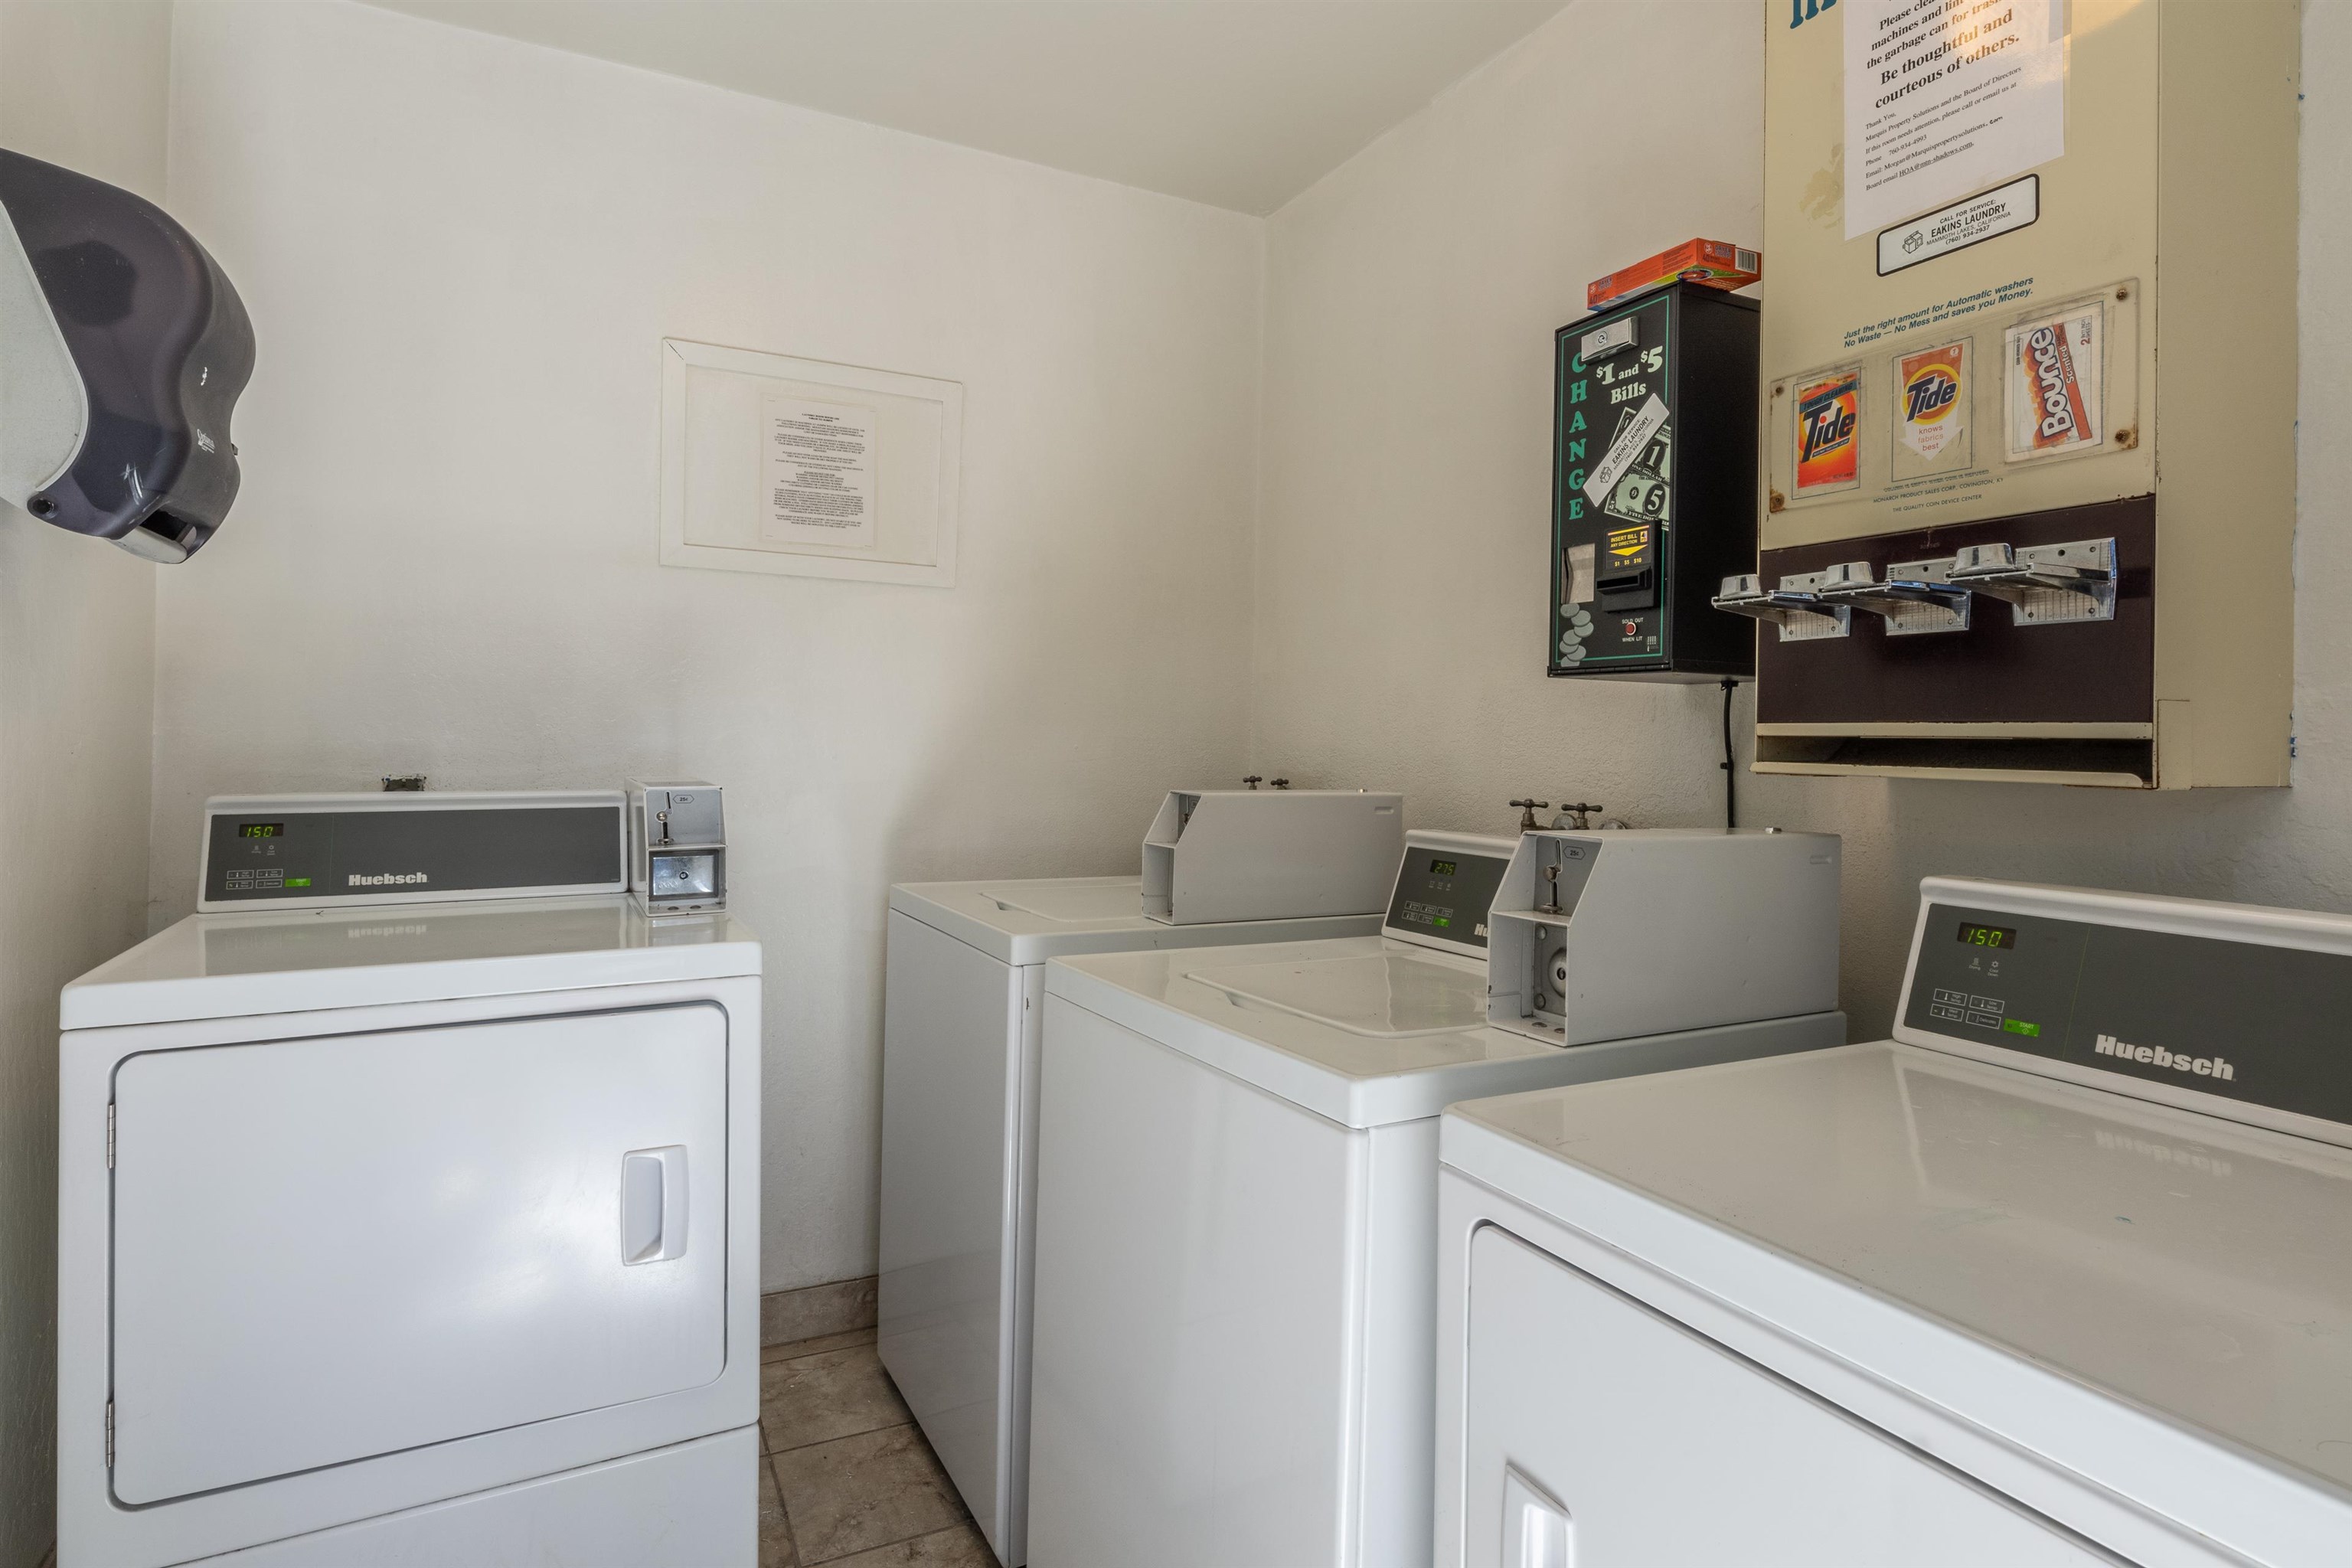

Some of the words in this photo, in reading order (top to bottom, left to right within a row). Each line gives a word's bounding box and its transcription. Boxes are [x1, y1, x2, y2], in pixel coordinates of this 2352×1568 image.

[1871, 20, 1919, 51] machines
[1921, 6, 1942, 24] and
[1879, 9, 1911, 31] Please
[1867, 54, 1881, 69] the
[1884, 33, 1926, 61] garbage
[1929, 21, 1949, 37] can
[1952, 11, 1968, 26] for
[1880, 64, 1899, 85] Be
[1902, 26, 1979, 74] thoughtful
[1983, 8, 2014, 34] and
[1875, 68, 1943, 109] courteous
[1947, 57, 1962, 74] of
[1965, 34, 2020, 65] others.
[1866, 129, 1887, 142] Marquis
[1888, 117, 1912, 131] Property
[1913, 101, 1939, 120] Solutions
[1940, 98, 1952, 107] and
[1963, 83, 1982, 96] Board
[1983, 79, 1991, 87] of
[1992, 67, 2021, 83] Directors
[1865, 119, 1882, 129] Thank
[1882, 137, 1896, 147] room
[1897, 129, 1913, 139] needs
[1914, 117, 1941, 132] attention,
[1942, 107, 1961, 121] please
[1962, 101, 1973, 110] call
[1982, 89, 2000, 101] email
[1865, 155, 1882, 166] Phone
[1865, 179, 1883, 191] Board
[1883, 172, 1898, 183] email
[1931, 220, 1962, 238] EAKINS
[1965, 203, 2006, 226] LAUNDRY
[1939, 215, 1954, 224] CALL
[1955, 210, 1968, 218] FOR
[1969, 199, 1996, 214] SERVICE:
[1926, 231, 1955, 246] MAMMOTH
[1978, 211, 2011, 227] CALIFORNIA
[1945, 235, 1961, 246] (760)
[1962, 224, 1990, 239] 934-2937
[1844, 328, 1861, 339] Just
[1862, 324, 1876, 334] the
[1877, 316, 1896, 333] right
[1897, 308, 1930, 323] amount
[1931, 302, 1945, 314] for
[1945, 289, 1992, 309] Automatic
[1994, 277, 2034, 295] washers
[1844, 338, 1856, 348] No
[1857, 332, 1882, 344] Waste
[1894, 325, 1906, 334] No
[1908, 318, 1930, 330] Mess
[1932, 312, 1949, 322] and
[1951, 306, 1975, 317] saves
[1978, 299, 1996, 311] you
[1998, 288, 2034, 304] Money.
[2080, 338, 2090, 346] 2
[1596, 363, 1615, 385] $1
[1619, 364, 1639, 380] and
[1640, 345, 1664, 373] $5
[2059, 345, 2076, 384] Scented
[1610, 382, 1646, 404] Bills
[2030, 327, 2074, 439] Bounce
[1906, 374, 1958, 423] Tide
[1612, 443, 1628, 464] EAKINS
[1628, 416, 1649, 443] LAUNDRY
[1801, 400, 1857, 464] Tide
[1918, 425, 1943, 435] knows
[1918, 433, 1944, 444] fabrics
[1646, 446, 1661, 468] 1
[1922, 443, 1939, 452] best
[1648, 489, 1664, 511] 5
[1873, 494, 1899, 504] MONARCH
[1900, 490, 1923, 499] PRODUCT
[1903, 503, 1925, 511] QUALITY
[1961, 494, 1982, 502] CENTER
[1611, 534, 1627, 543] INSERT
[246, 826, 274, 838] 150
[348, 872, 428, 887] Huebsch
[1434, 863, 1455, 875] 275
[1967, 928, 2003, 947] 150
[2095, 1034, 2234, 1081] Huebsch
